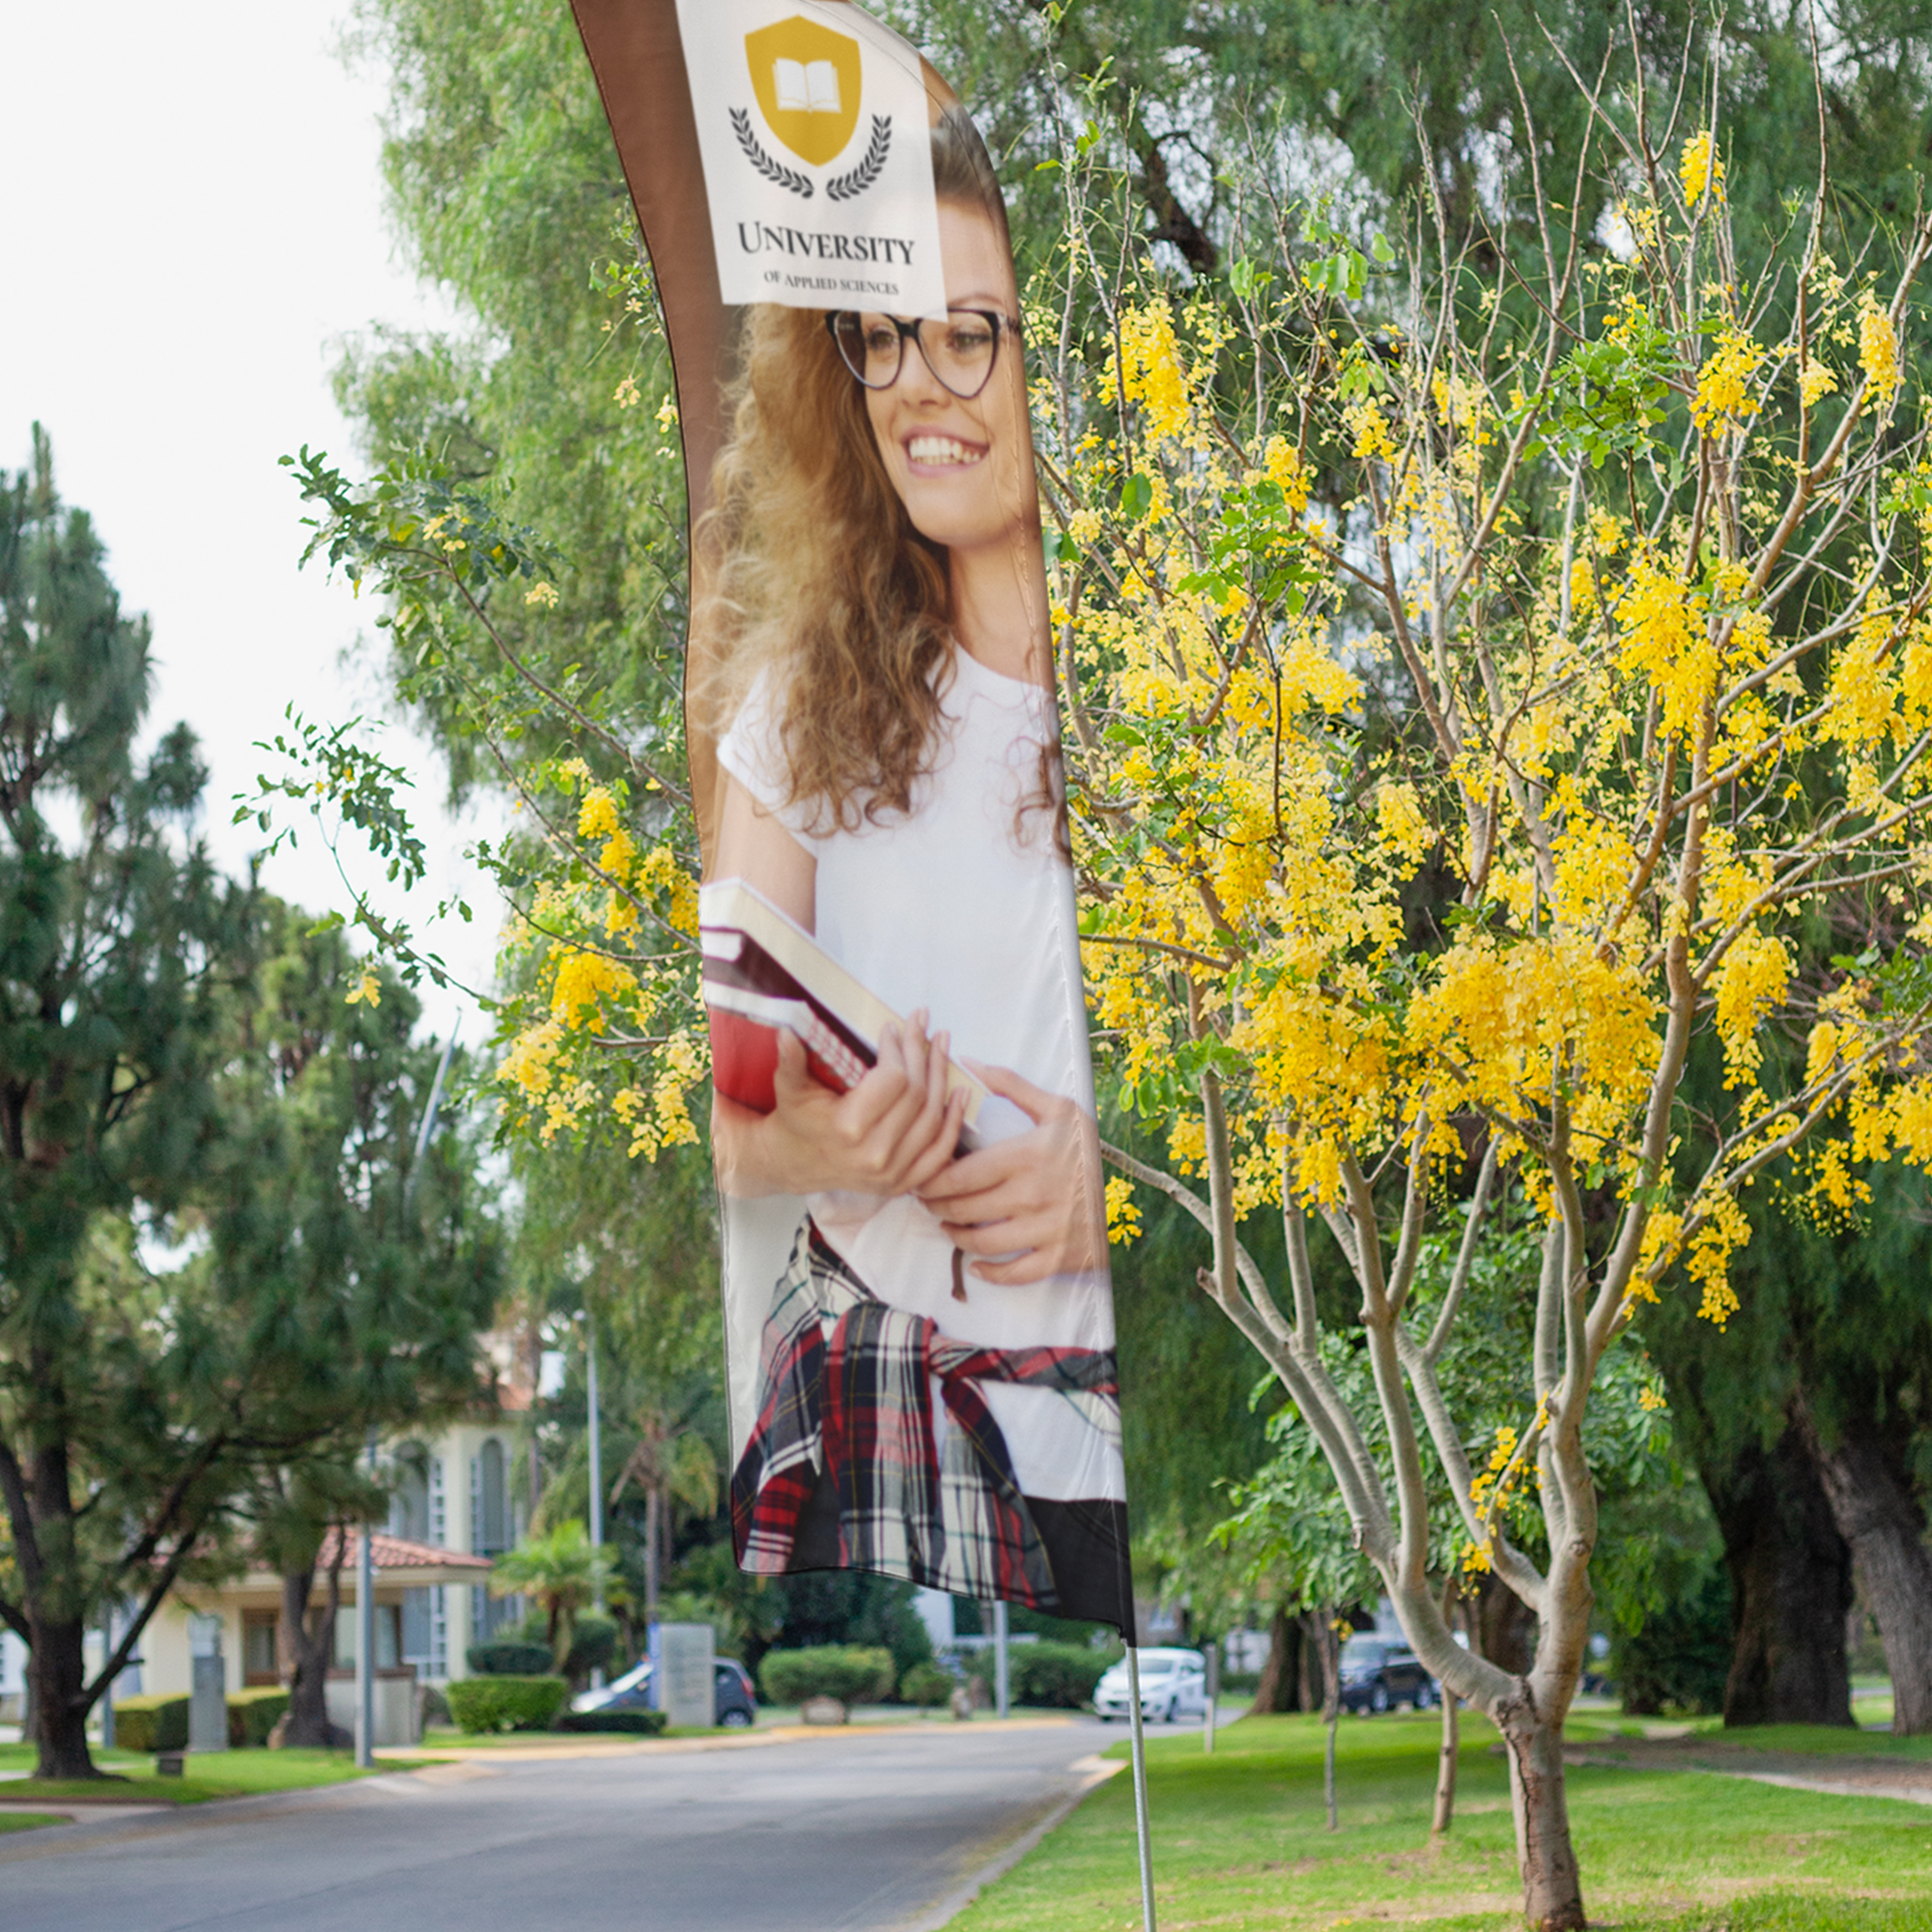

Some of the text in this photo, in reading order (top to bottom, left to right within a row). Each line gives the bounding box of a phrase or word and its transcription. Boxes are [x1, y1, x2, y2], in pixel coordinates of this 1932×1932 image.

[738, 220, 915, 265] UNIVERSITY
[764, 270, 899, 295] OF APPLIED SCIENCES
